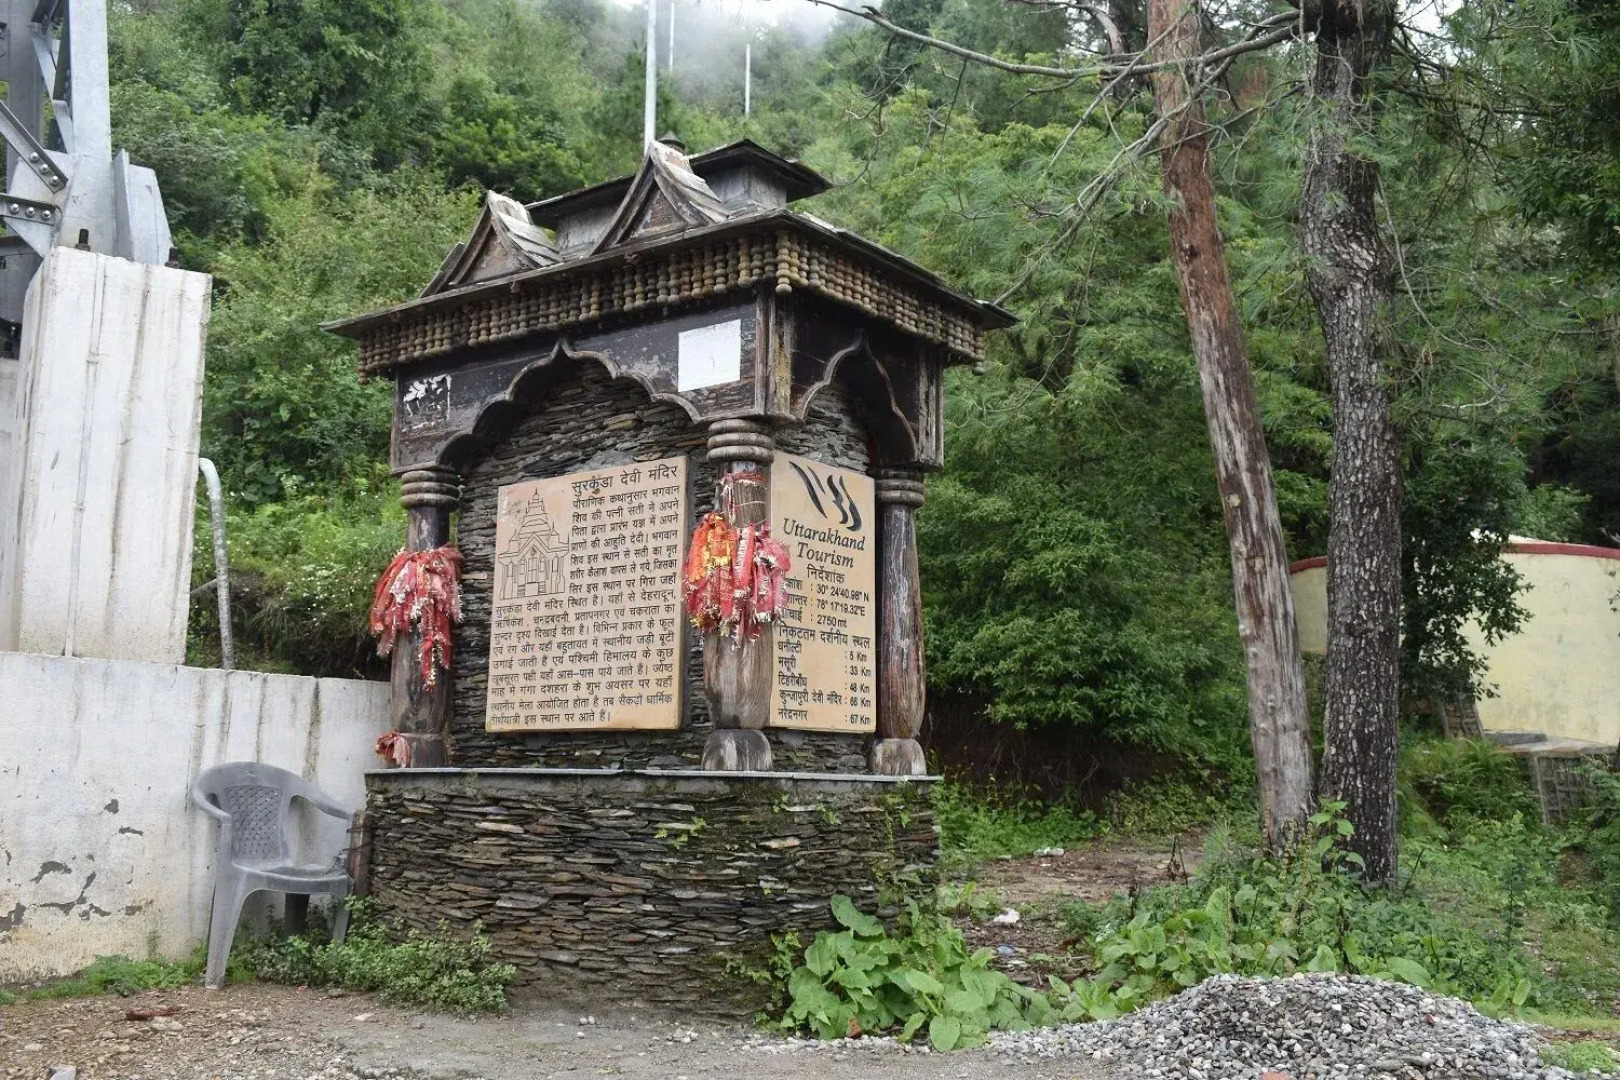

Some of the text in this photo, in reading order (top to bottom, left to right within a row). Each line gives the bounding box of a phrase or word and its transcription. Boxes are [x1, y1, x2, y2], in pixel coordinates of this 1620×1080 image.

[620, 471, 641, 485] देवी
[648, 465, 678, 480] मंदिर
[609, 490, 647, 504] कथानुसार
[652, 485, 679, 496] भगवान
[573, 498, 678, 523] शिव की पत्नी सती ने अपने
[572, 526, 587, 537] पिता
[592, 525, 606, 535] द्वारा
[633, 519, 645, 528] यज्ञ
[660, 513, 678, 524] अपने
[783, 518, 865, 551] Uttarakhand
[591, 538, 600, 548] की
[604, 534, 625, 550] आहुति
[652, 530, 677, 541] भगवान
[571, 545, 677, 565] शिव इस स्थान से सती का मृत
[797, 542, 854, 568] Tourism
[570, 568, 584, 579] शरीर
[588, 566, 607, 577] कैलाश
[630, 562, 636, 573] ले
[654, 559, 677, 569] जिसका
[569, 583, 582, 594] सिर
[587, 583, 598, 592] इस
[603, 581, 621, 590] स्थान
[626, 579, 635, 587] पर
[640, 575, 655, 586] गिरा
[527, 601, 540, 611] देवी
[545, 599, 563, 609] मंदिर
[568, 597, 587, 608] स्थित
[628, 590, 636, 602] से
[864, 593, 869, 602] N
[575, 610, 609, 621] प्रतापनगर
[614, 606, 626, 618] एवं
[630, 606, 659, 618] चकराता
[664, 604, 675, 614] का
[494, 633, 512, 645] सुन्दर
[516, 631, 530, 642] दृश्य
[535, 626, 556, 638] दिखाई
[561, 625, 575, 635] देता
[593, 623, 618, 633] विभिन्न
[622, 621, 642, 631] प्रकार
[647, 618, 655, 628] के
[659, 618, 674, 631] फूल
[779, 621, 870, 648] निकटतम दर्शनीय स्थल
[521, 640, 534, 653] और
[557, 638, 587, 653] बहुतायत
[603, 634, 632, 647] स्थानीय
[660, 632, 674, 646] बूटी
[493, 657, 513, 669] उगाई
[517, 655, 537, 667] जाती
[603, 649, 637, 662] हिमालय
[642, 647, 651, 658] के
[657, 648, 674, 662] कुछ
[857, 651, 867, 662] Km
[523, 670, 537, 681] पक्षी
[598, 665, 612, 677] पाये
[617, 664, 633, 676] जाते
[850, 666, 858, 675] 33
[861, 667, 871, 677] Km
[491, 686, 505, 696] माह
[520, 685, 536, 695] गंगा
[541, 684, 568, 693] दशहरा
[573, 681, 581, 691] के
[587, 682, 600, 695] शुभ
[606, 680, 633, 691] अवसर
[638, 680, 650, 689] पर
[860, 683, 869, 693] Km
[519, 699, 533, 709] मेला
[536, 697, 569, 709] आयोजित
[573, 696, 589, 707] होता
[603, 698, 614, 706] तब
[647, 693, 672, 704] धार्मिक
[812, 689, 823, 703] देवी
[861, 697, 871, 707] Km
[524, 713, 536, 725] इस
[540, 712, 560, 723] स्थान
[565, 712, 574, 722] पर
[579, 710, 594, 721] आते
[850, 714, 858, 724] 67
[860, 715, 871, 725] Km
